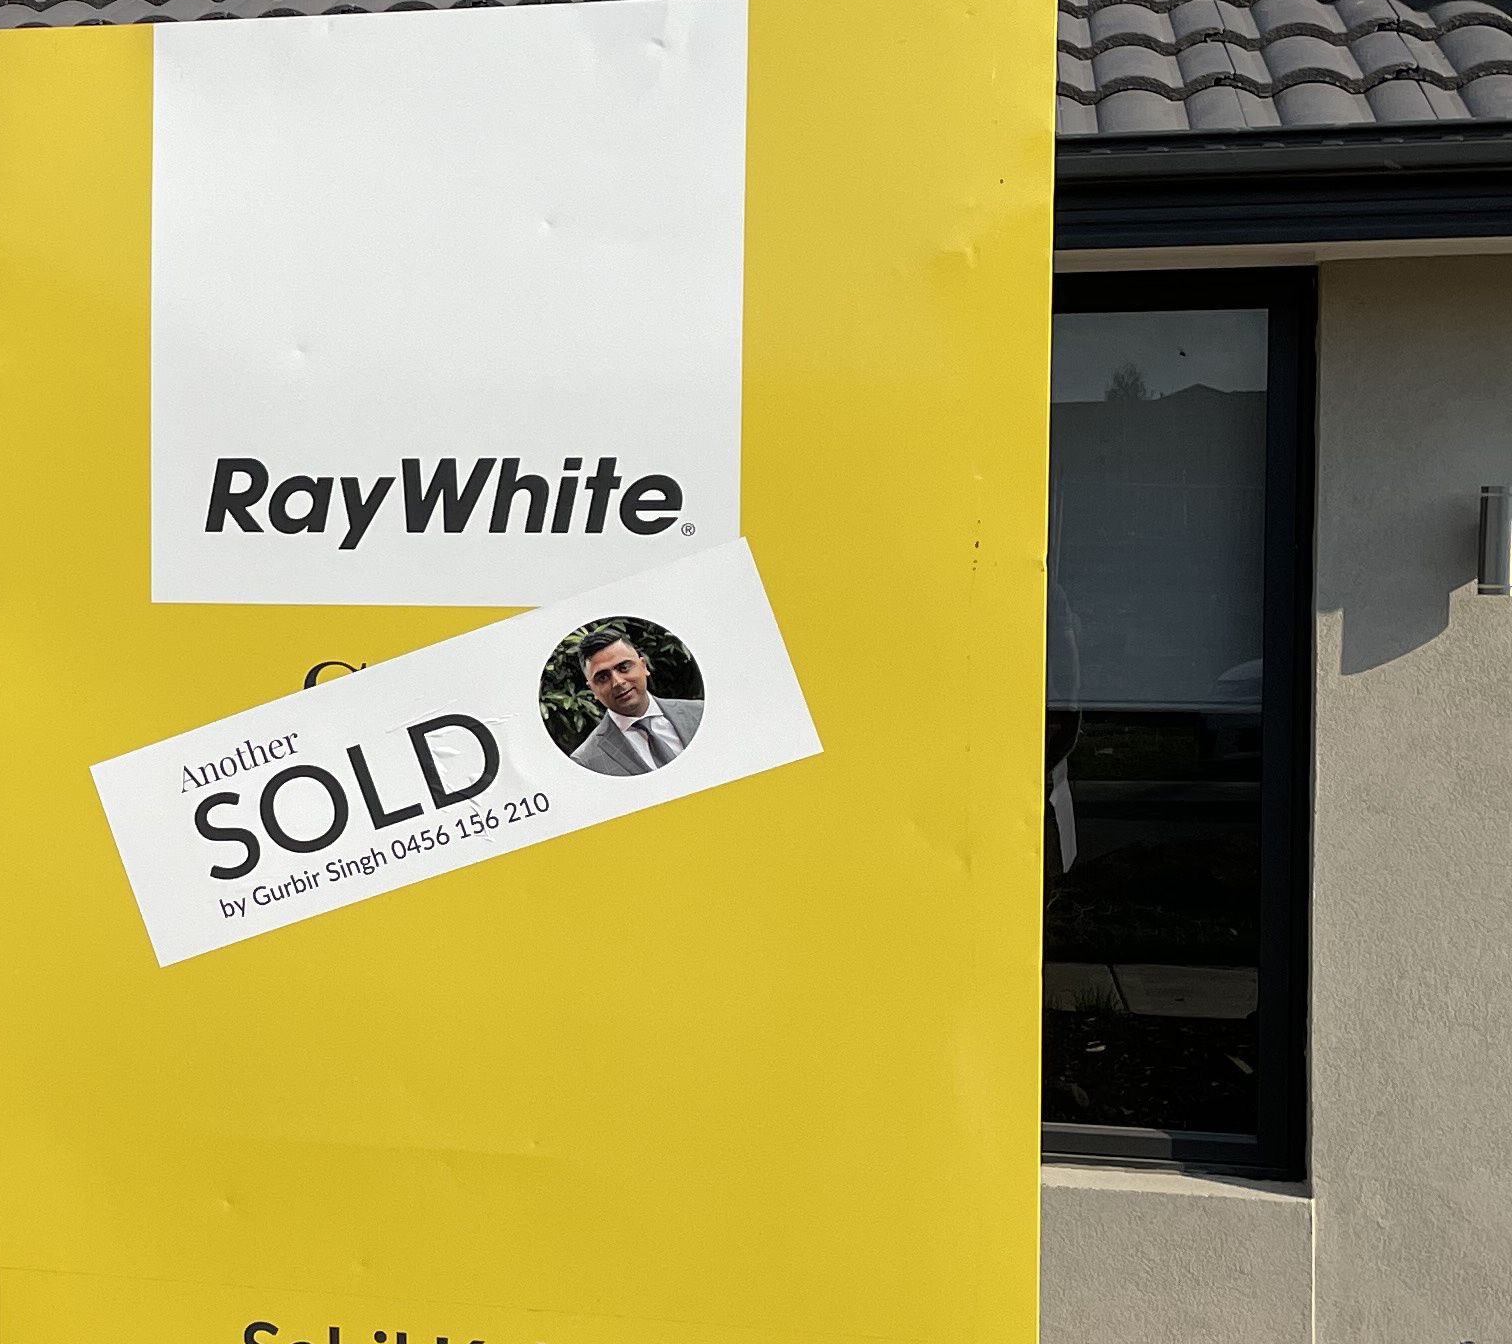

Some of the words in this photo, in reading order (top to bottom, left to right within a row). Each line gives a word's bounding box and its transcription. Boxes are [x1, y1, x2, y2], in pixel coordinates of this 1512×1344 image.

[181, 731, 299, 793] Another
[194, 714, 500, 880] SOLD
[219, 897, 246, 919] by
[252, 869, 320, 906] Gurbir
[325, 847, 388, 882] Singh
[391, 824, 450, 860] 0456
[455, 808, 499, 840] 156
[503, 792, 550, 824] 210
